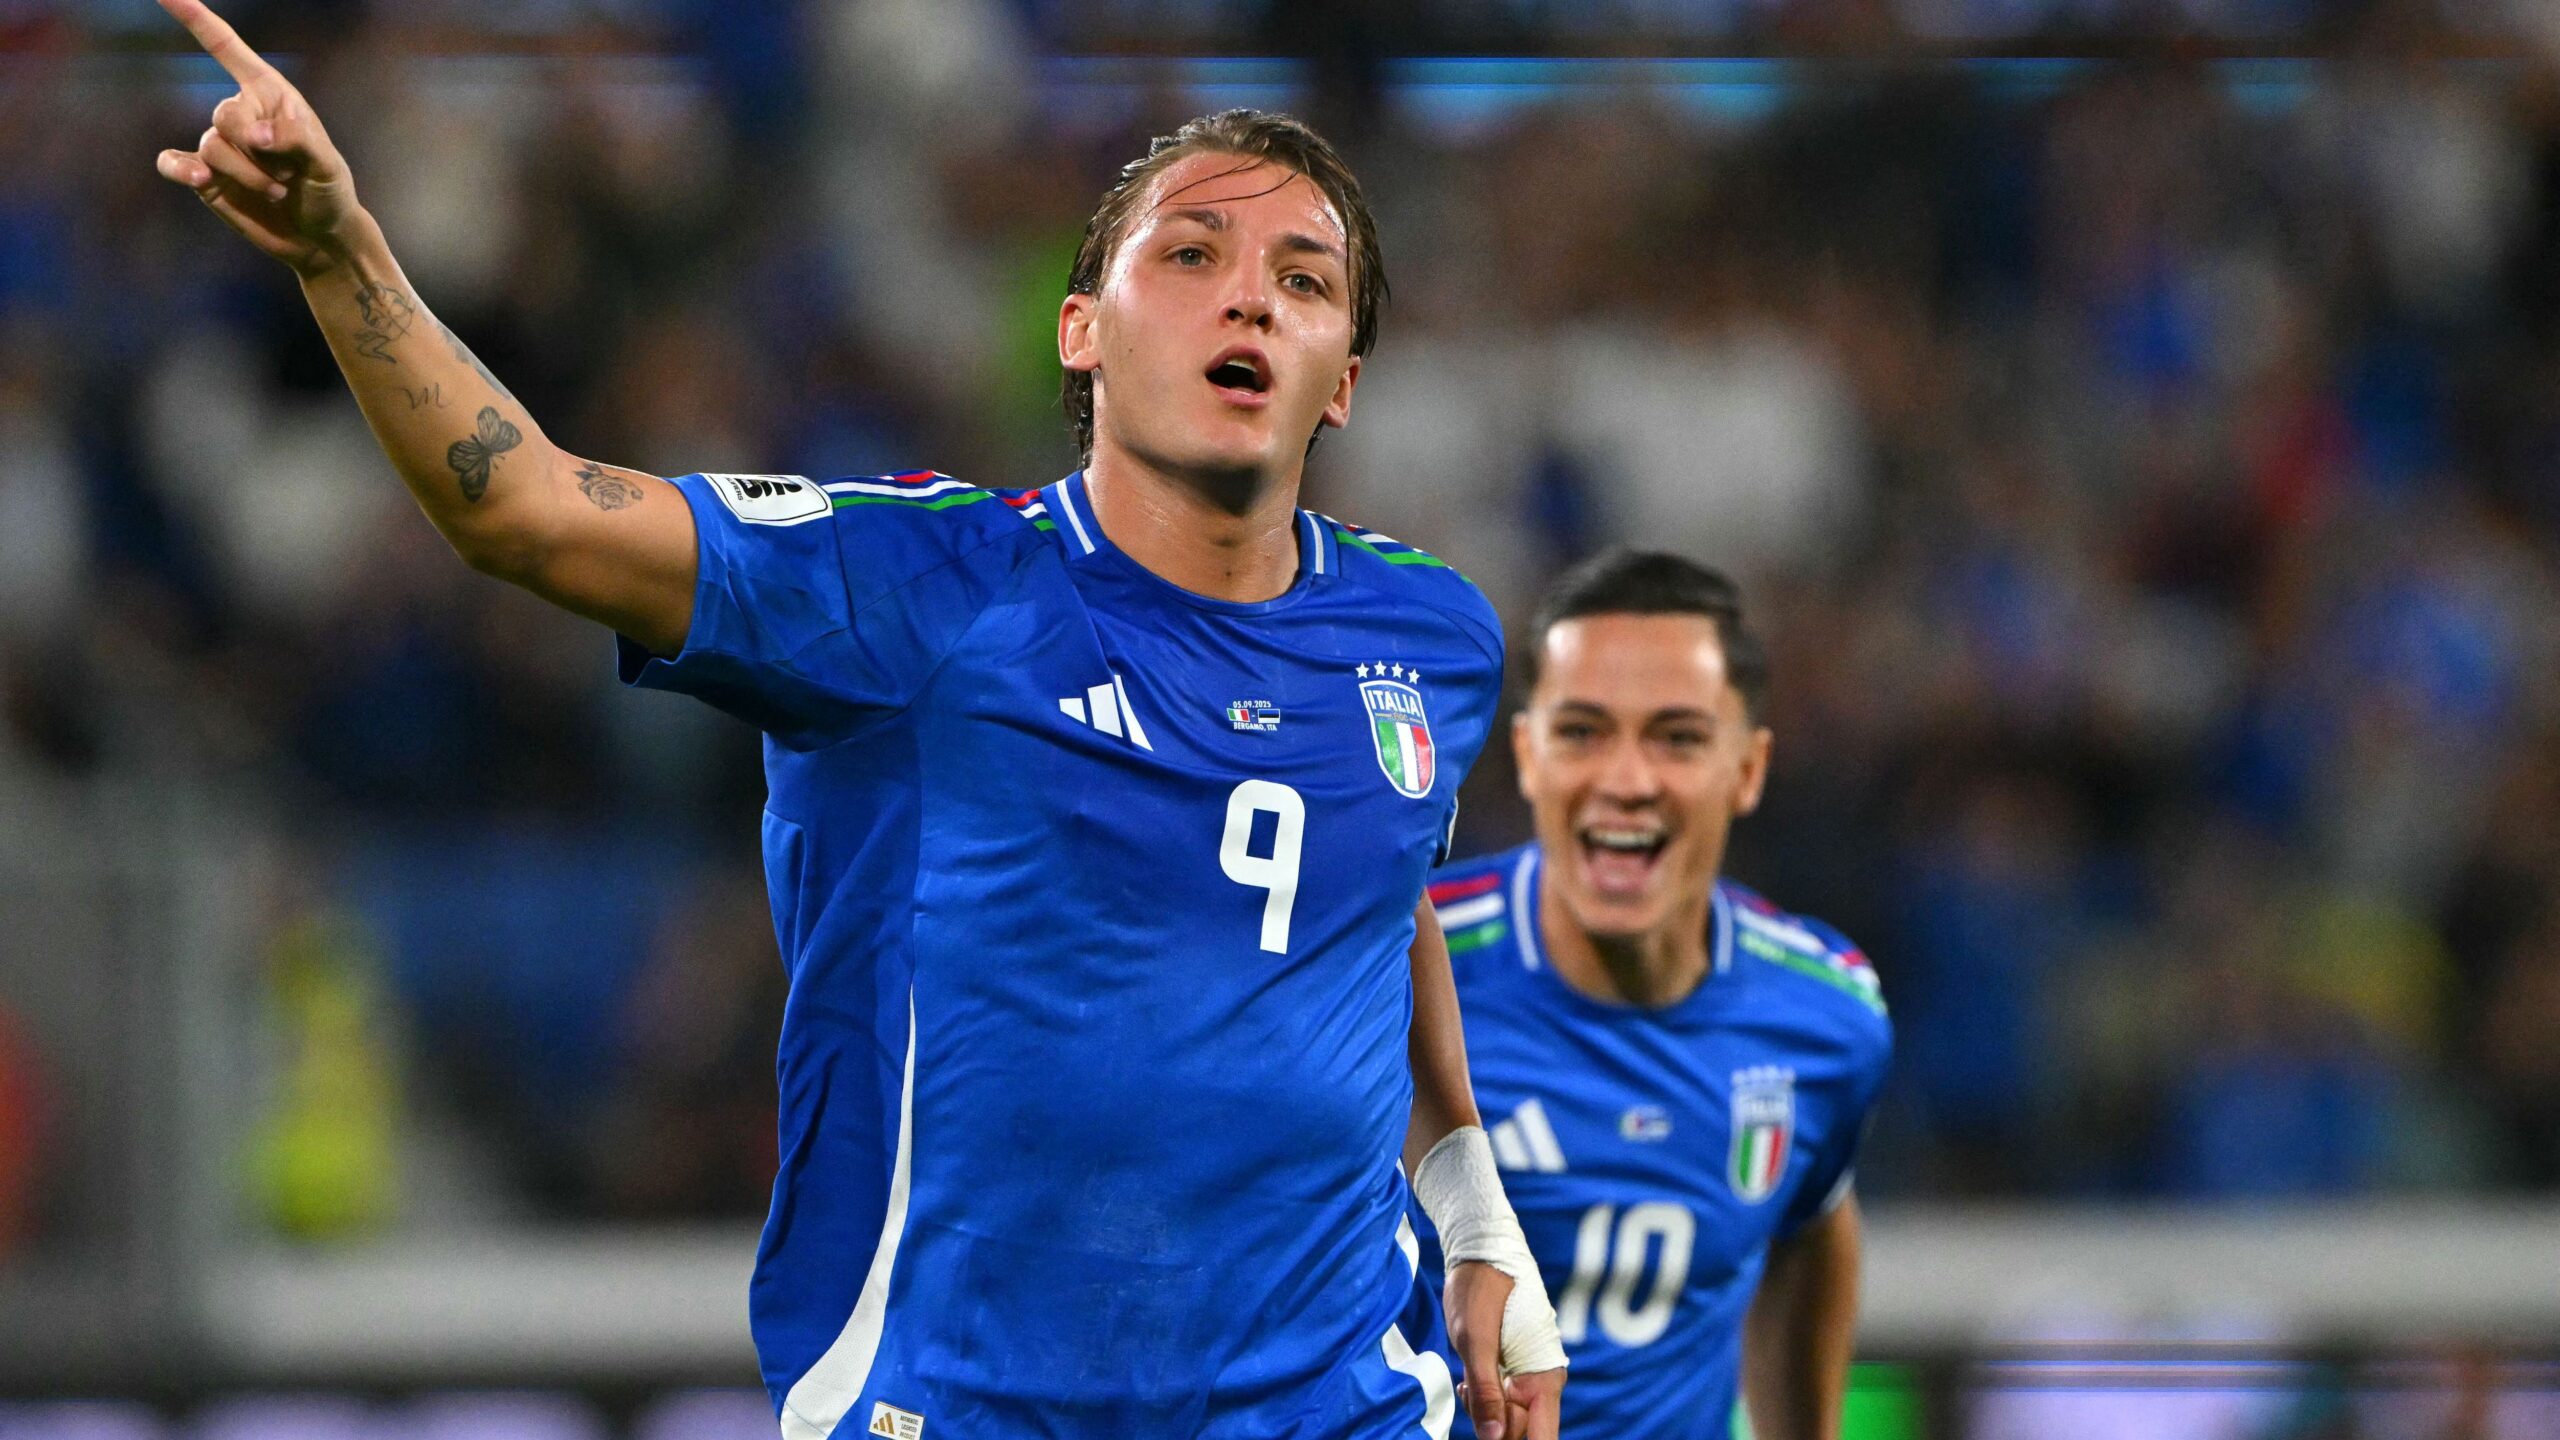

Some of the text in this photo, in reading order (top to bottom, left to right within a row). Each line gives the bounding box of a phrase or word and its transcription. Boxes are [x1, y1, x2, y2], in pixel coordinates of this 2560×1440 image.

[1233, 700, 1271, 708] 05.09.2025
[1367, 689, 1421, 718] ITALIA
[1233, 722, 1266, 732] BERGAMO,
[1219, 779, 1306, 955] 9
[1557, 1202, 1698, 1348] 10
